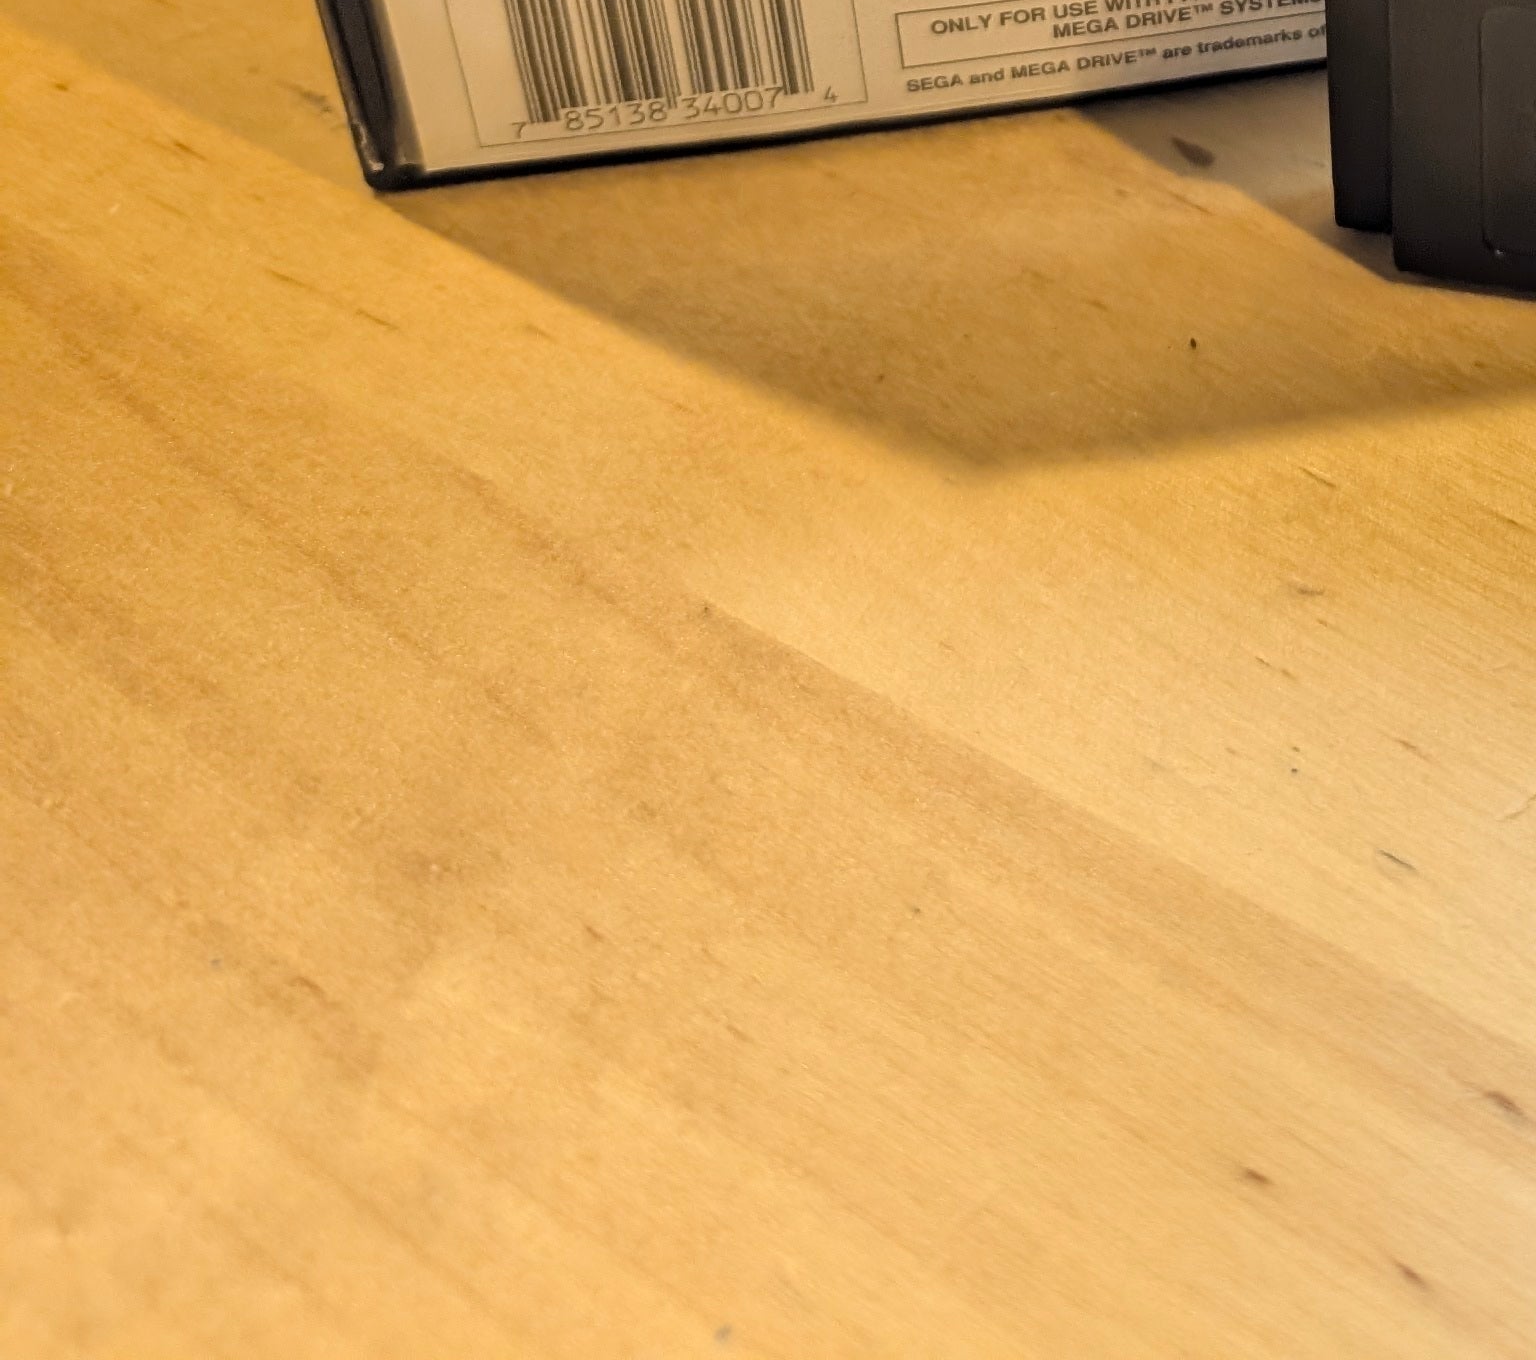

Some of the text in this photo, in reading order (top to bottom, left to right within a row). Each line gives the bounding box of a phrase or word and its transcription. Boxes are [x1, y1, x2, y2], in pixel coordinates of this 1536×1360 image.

[930, 13, 992, 35] ONLY
[999, 7, 1046, 27] FOR
[1053, 0, 1098, 19] USE
[1053, 17, 1119, 39] MEGA
[563, 101, 669, 131] 85138
[681, 85, 784, 120] 34007
[824, 85, 839, 103] 4
